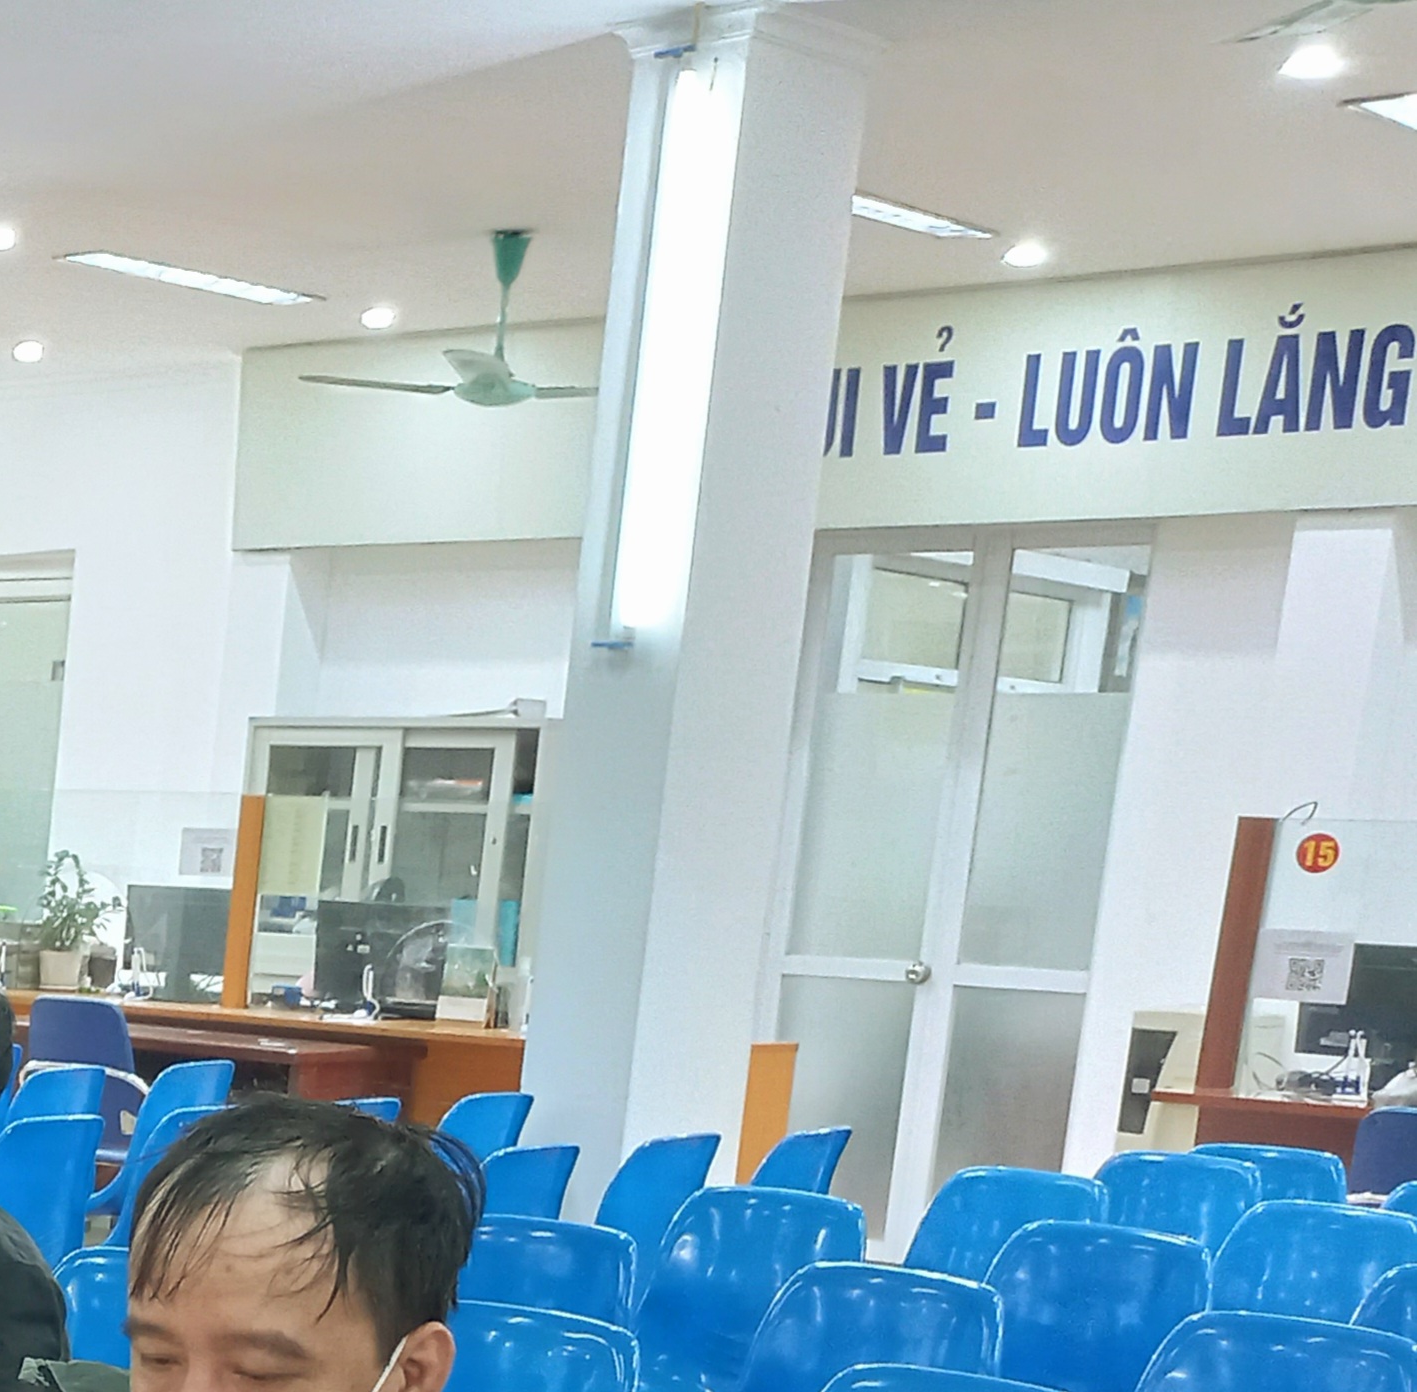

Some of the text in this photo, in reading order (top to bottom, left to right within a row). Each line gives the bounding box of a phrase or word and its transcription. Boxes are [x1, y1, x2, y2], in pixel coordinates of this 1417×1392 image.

[881, 324, 955, 456] VẺ
[1016, 327, 1201, 448] LUÔN
[1215, 302, 1415, 438] LẮNG
[1302, 840, 1336, 867] 15
